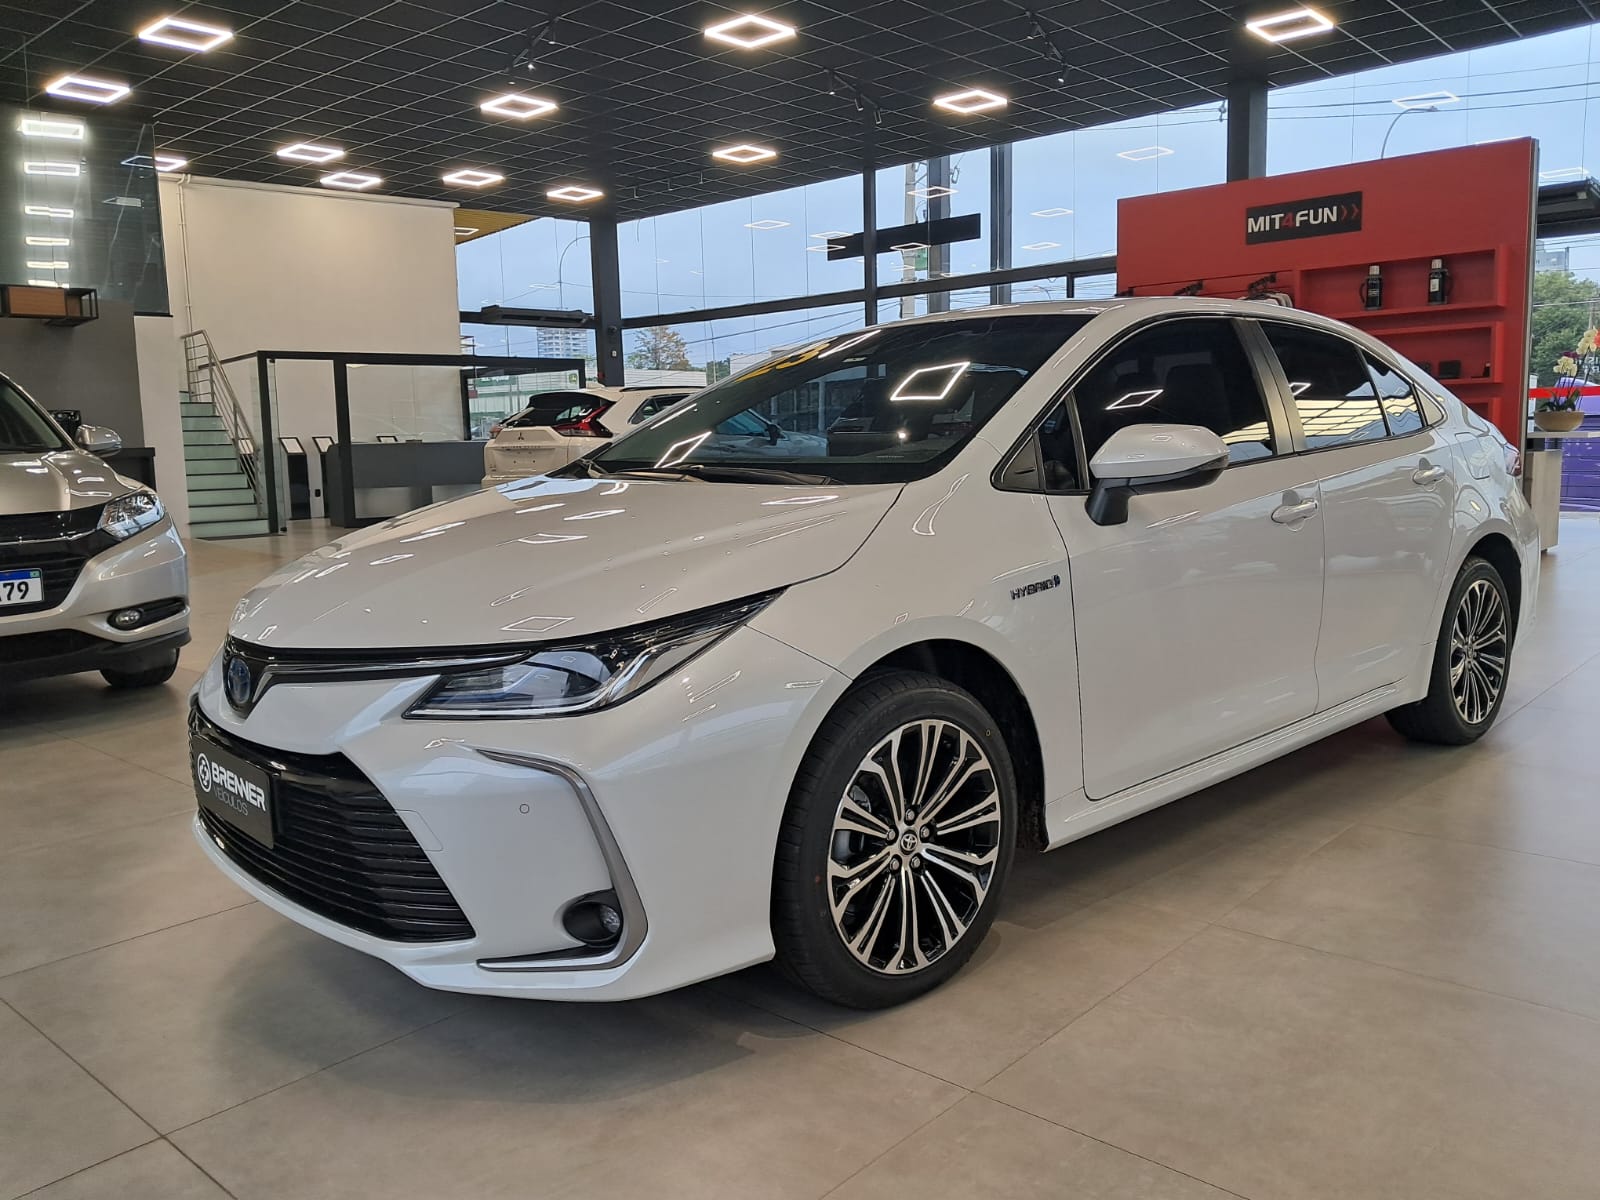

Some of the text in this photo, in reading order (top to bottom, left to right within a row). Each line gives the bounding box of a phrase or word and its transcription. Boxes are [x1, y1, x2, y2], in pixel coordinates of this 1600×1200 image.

[1247, 205, 1338, 233] MIT4FUN
[0, 581, 29, 601] 79
[1010, 578, 1054, 600] HYBRID
[211, 761, 266, 812] BRENNER
